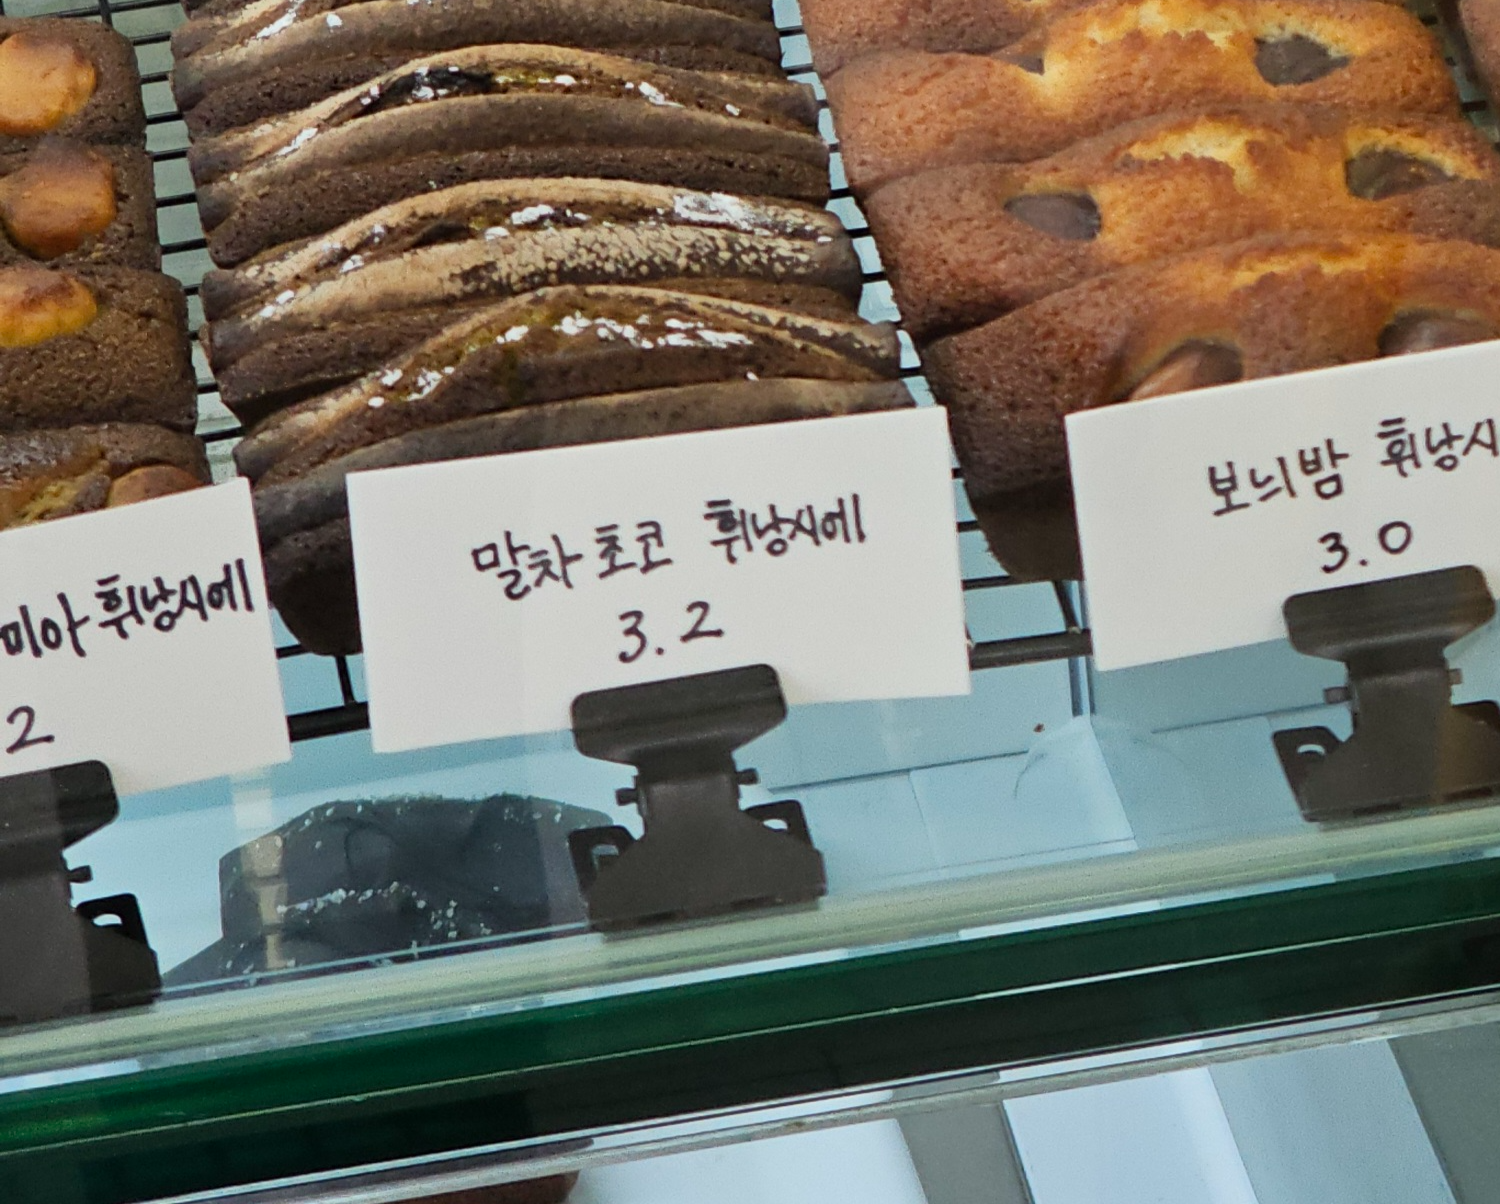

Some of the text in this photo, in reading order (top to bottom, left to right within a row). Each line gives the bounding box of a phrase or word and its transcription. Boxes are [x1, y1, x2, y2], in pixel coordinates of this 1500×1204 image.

[1207, 438, 1350, 517] 보늬밤
[703, 492, 867, 565] 휘낭시에
[1318, 520, 1413, 574] 3.0
[94, 557, 255, 639] 휘낭시에
[618, 600, 725, 664] 3.2
